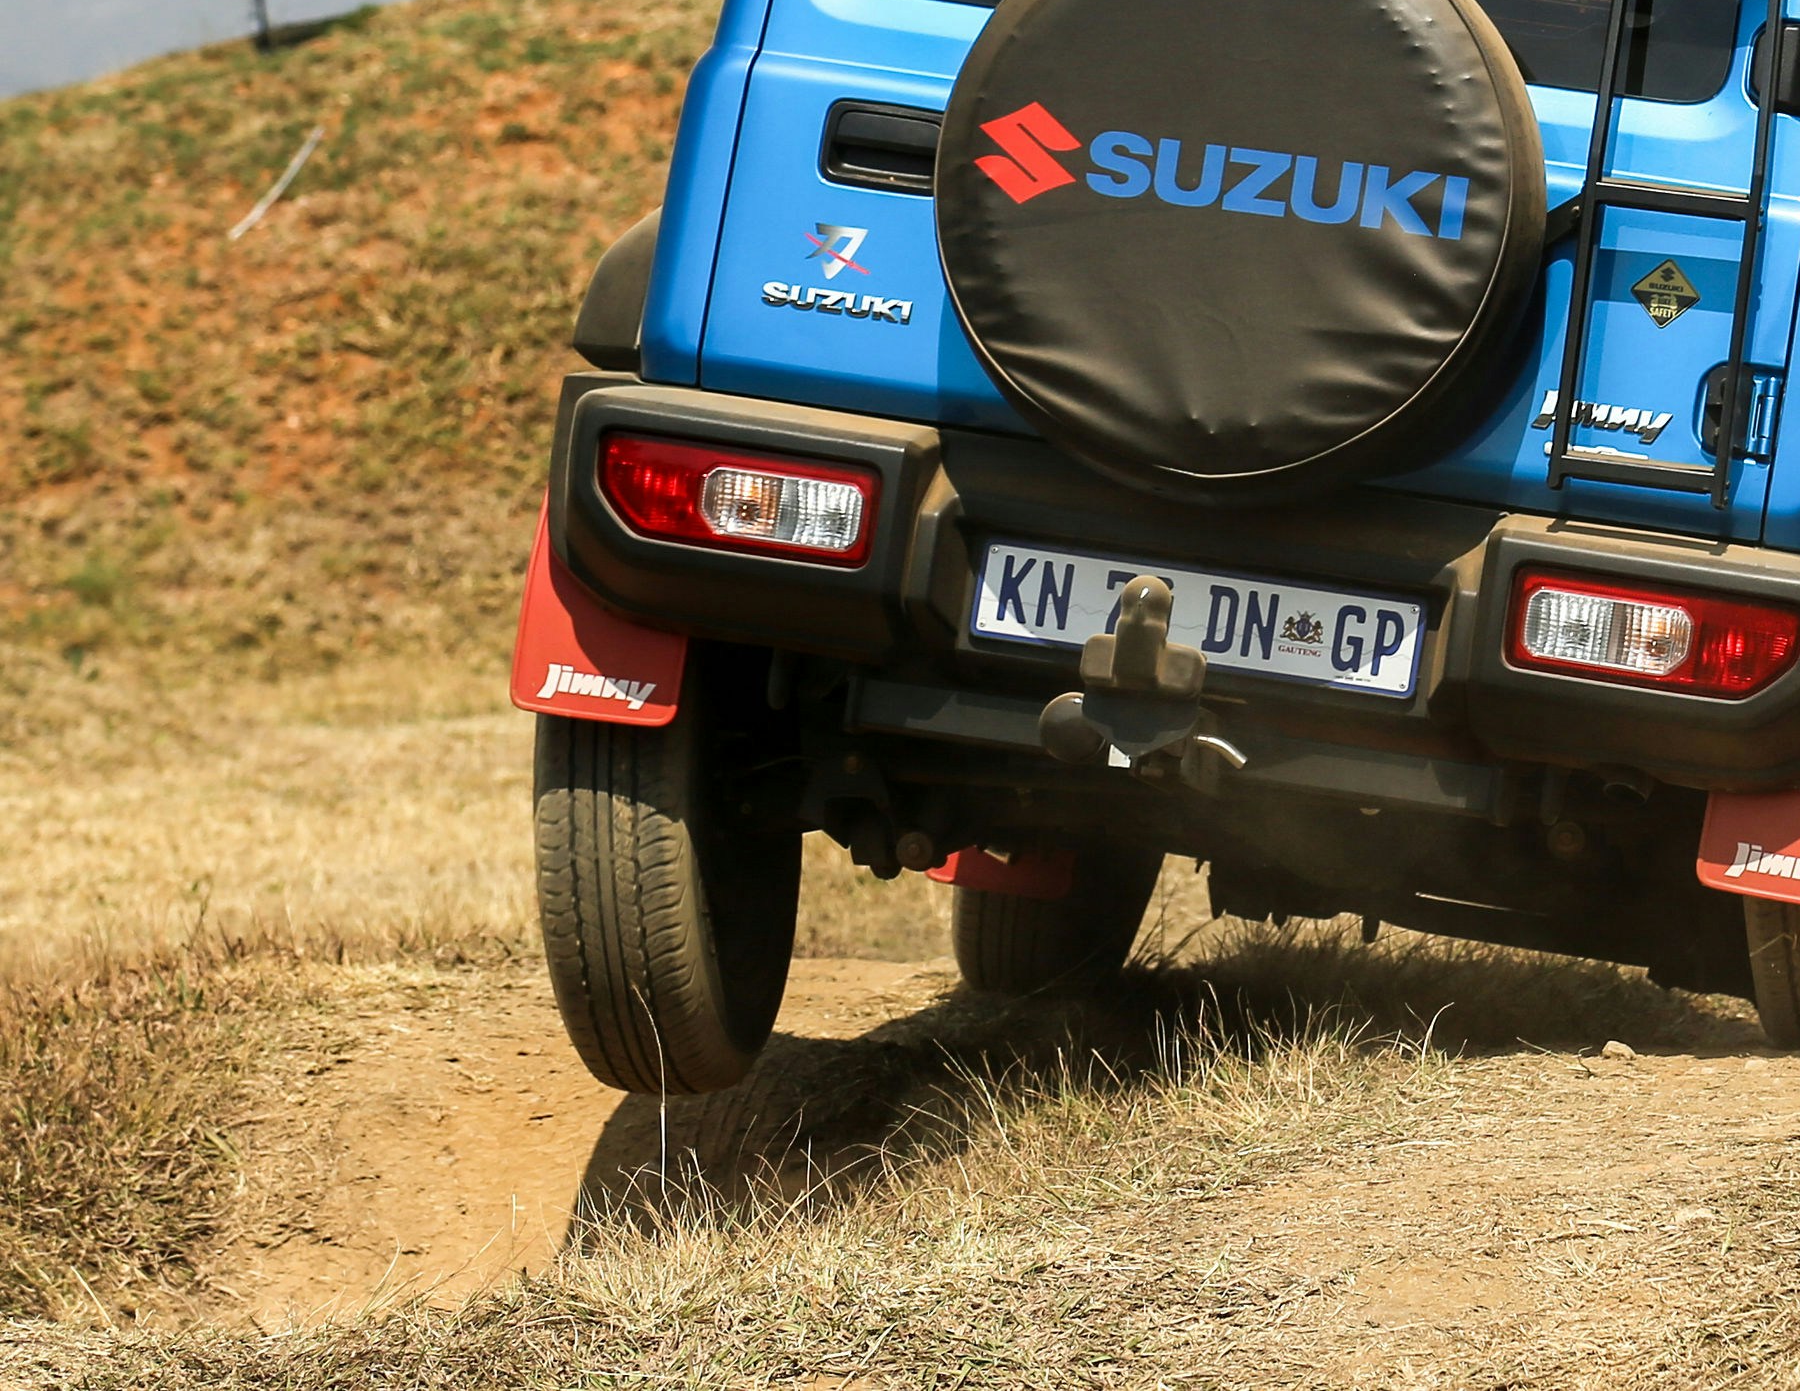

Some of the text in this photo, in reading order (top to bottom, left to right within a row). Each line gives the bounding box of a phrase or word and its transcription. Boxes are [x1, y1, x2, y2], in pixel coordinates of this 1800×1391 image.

[1086, 130, 1470, 241] SUZUKI
[761, 281, 913, 325] SUZUKI
[1649, 307, 1678, 319] SAFETY
[1531, 389, 1673, 444] Jmny
[996, 554, 1076, 631] KN
[1201, 584, 1281, 661] DN
[1331, 604, 1405, 677] GP
[1277, 644, 1322, 658] GAUTENG
[536, 663, 657, 711] Jimny
